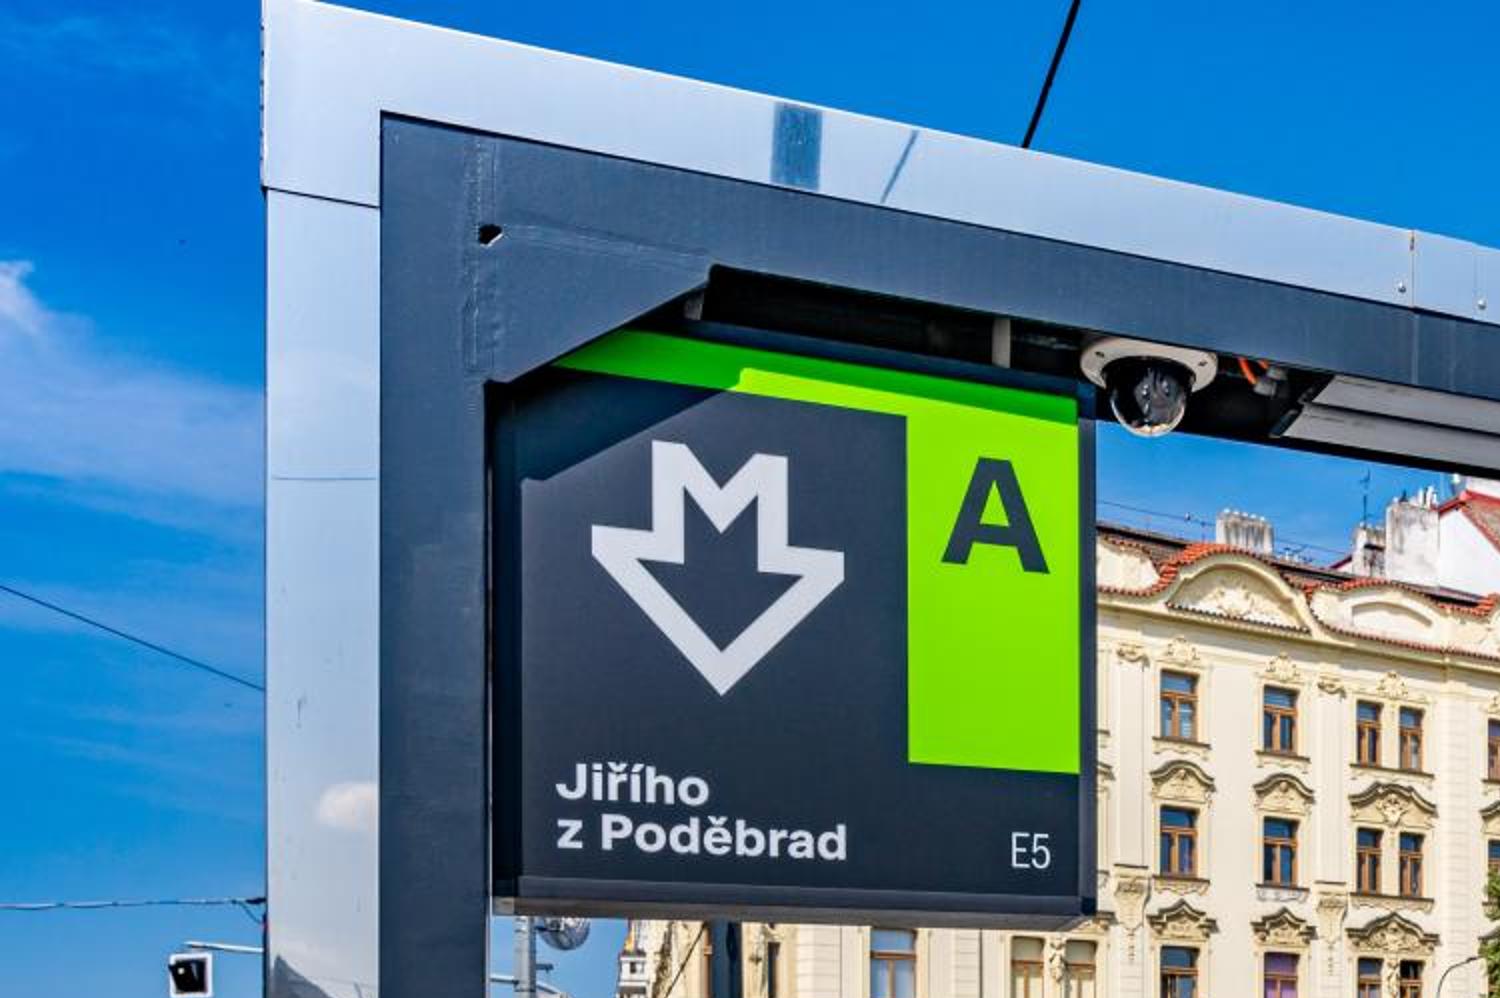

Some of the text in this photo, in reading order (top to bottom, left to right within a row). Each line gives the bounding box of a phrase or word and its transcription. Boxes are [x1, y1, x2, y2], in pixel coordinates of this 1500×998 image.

[941, 456, 1050, 574] A
[555, 761, 710, 807] Jiřího
[556, 813, 848, 861] z Poděbrad
[1010, 832, 1051, 871] E5
